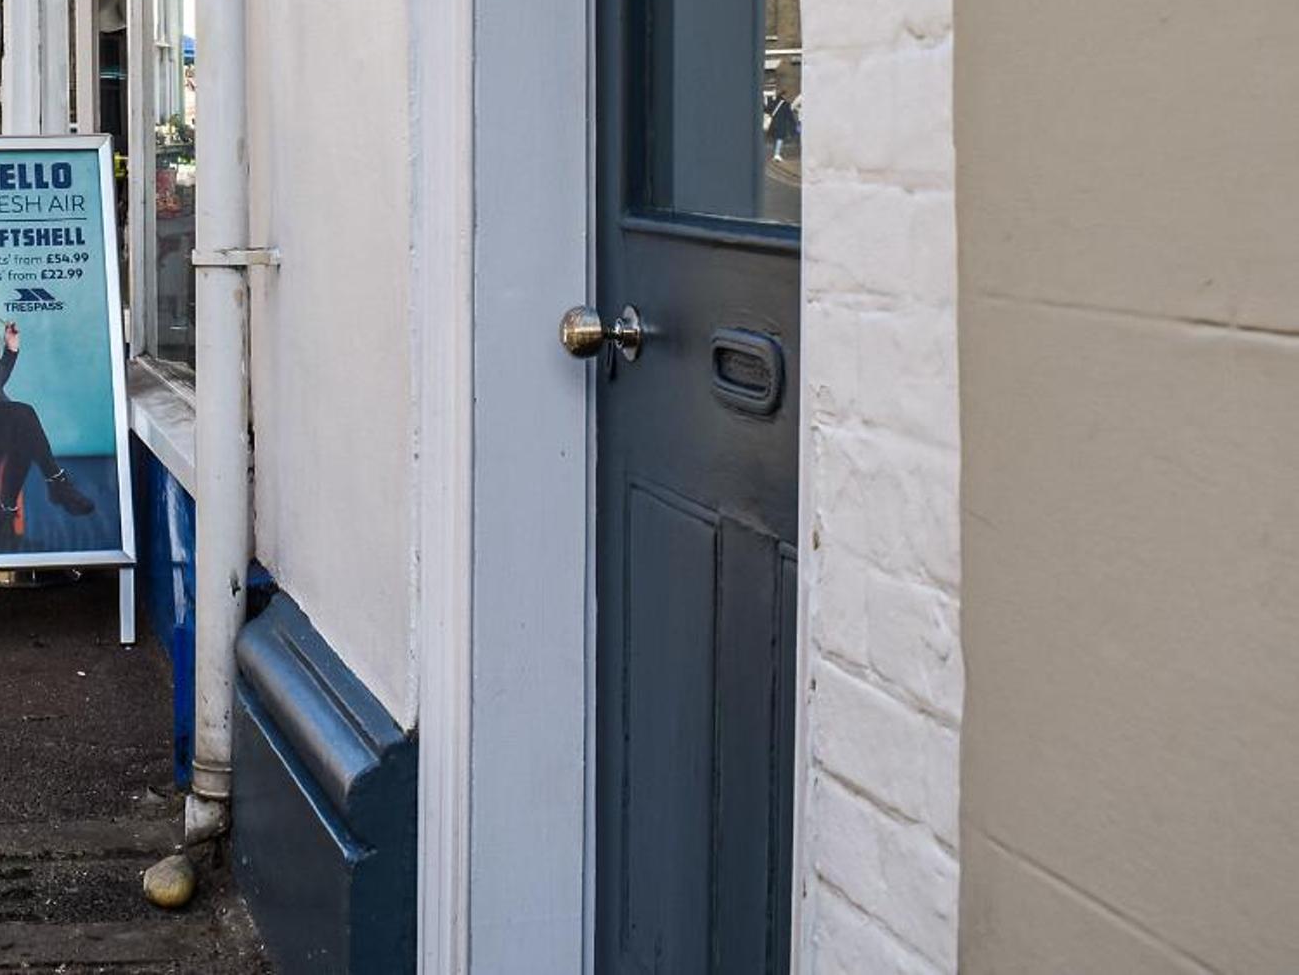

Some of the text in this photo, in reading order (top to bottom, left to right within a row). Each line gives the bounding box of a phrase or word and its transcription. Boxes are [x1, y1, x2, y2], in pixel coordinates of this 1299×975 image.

[48, 194, 86, 213] AIR
[14, 255, 43, 266] from
[46, 252, 89, 265] £54.99
[8, 269, 38, 281] from
[40, 268, 84, 281] £22.99
[4, 301, 65, 313] TRESPASS
